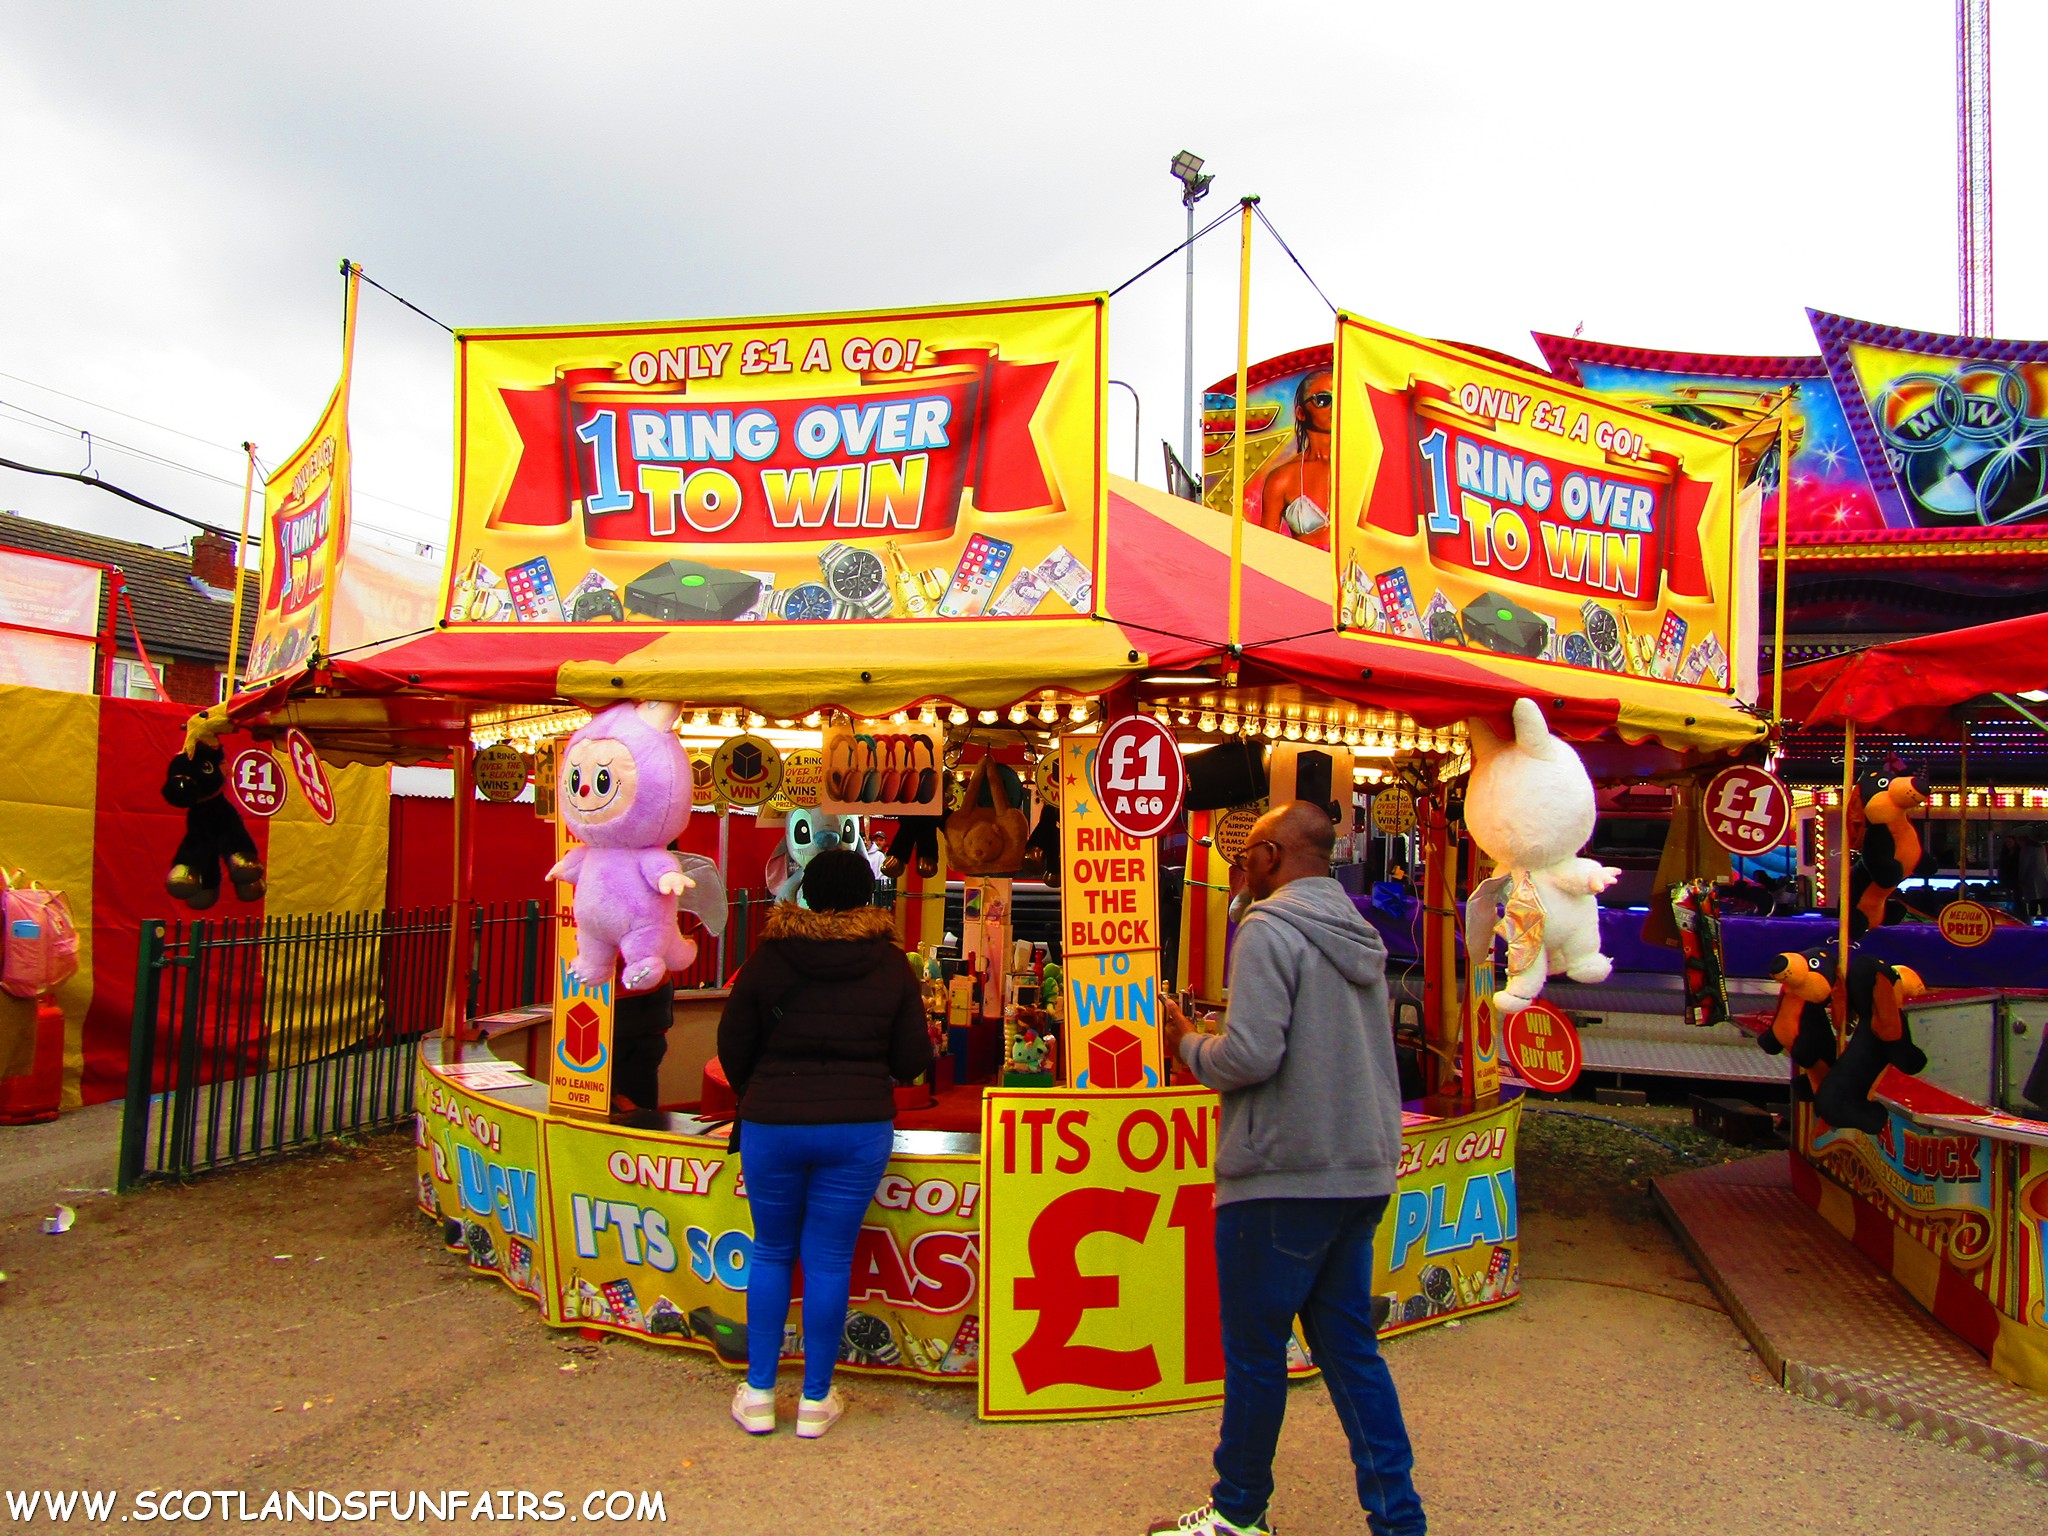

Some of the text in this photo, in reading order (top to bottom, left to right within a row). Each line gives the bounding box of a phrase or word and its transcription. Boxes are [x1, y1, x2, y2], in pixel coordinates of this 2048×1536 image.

[629, 337, 922, 386] ONLY £1 A GO!
[1459, 383, 1643, 461] ONLY £1 A GO!
[576, 396, 952, 515] 1 RING OVER
[638, 453, 929, 536] TO WIN
[1418, 428, 1655, 535] 1 RING OVER
[281, 521, 292, 598] 1
[291, 509, 317, 556] RING
[1460, 490, 1641, 600] TO WIN
[290, 554, 308, 610] TO
[294, 741, 326, 796] £1
[480, 763, 503, 771] OVER
[489, 751, 495, 760] 1
[794, 755, 802, 766] 1
[1107, 734, 1166, 791] £1
[239, 759, 276, 792] £1
[482, 781, 519, 791] WINS 1
[489, 771, 516, 779] BLOCK
[785, 768, 810, 777] OVER
[245, 792, 275, 805] A GO
[730, 784, 760, 800] WIN
[787, 786, 817, 796] WINS
[796, 796, 818, 804] PRIZE
[1384, 794, 1390, 802] 1
[1713, 777, 1774, 826] £1
[1115, 796, 1163, 815] A GO
[1077, 828, 1141, 851] RING
[1717, 819, 1765, 842] A GO
[1073, 858, 1146, 883] OVER
[1083, 889, 1137, 914] THE
[1947, 922, 1984, 936] PRIZE
[1949, 910, 1982, 921] MEDIUM
[1071, 919, 1150, 946] BLOCK
[1095, 953, 1130, 975] TO
[1474, 963, 1494, 1000] WIN
[1071, 975, 1156, 1028] WIN
[1524, 1011, 1552, 1037] WIN
[1520, 1043, 1566, 1075] BUY ME
[555, 1076, 605, 1093] NO LEANING
[568, 1092, 591, 1104] OVER
[446, 1095, 463, 1127] A
[463, 1106, 500, 1151] GO!
[999, 1108, 1091, 1174] ITS
[1427, 1136, 1451, 1168] A
[1454, 1127, 1507, 1163] GO!
[1902, 1127, 1981, 1182] DUCK
[608, 1150, 725, 1196] ONLY
[874, 1173, 980, 1219] GO!
[1911, 1184, 1936, 1205] TIME
[572, 1193, 678, 1272] I'TS
[684, 1225, 755, 1292] SO
[1011, 1183, 1225, 1395] £1
